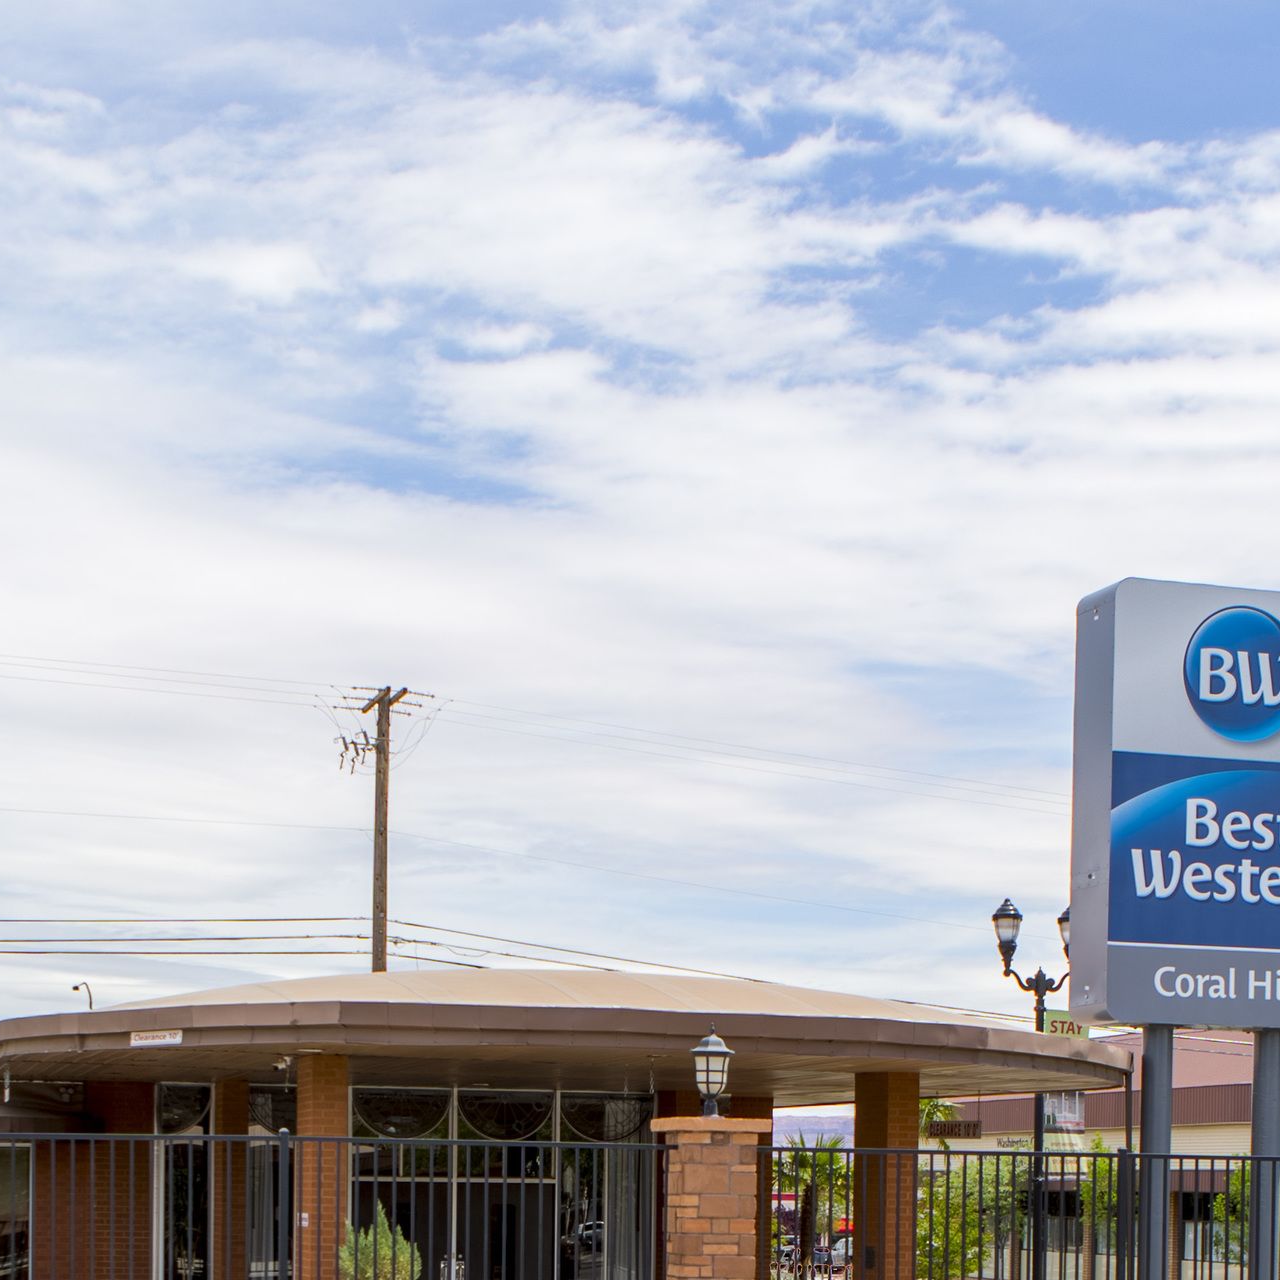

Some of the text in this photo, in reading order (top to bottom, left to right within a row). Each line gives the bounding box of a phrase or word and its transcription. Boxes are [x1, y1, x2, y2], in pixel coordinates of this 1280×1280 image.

[1153, 965, 1237, 999] Coral
[1050, 1020, 1082, 1035] STAY
[929, 1123, 961, 1137] CLEARANCE
